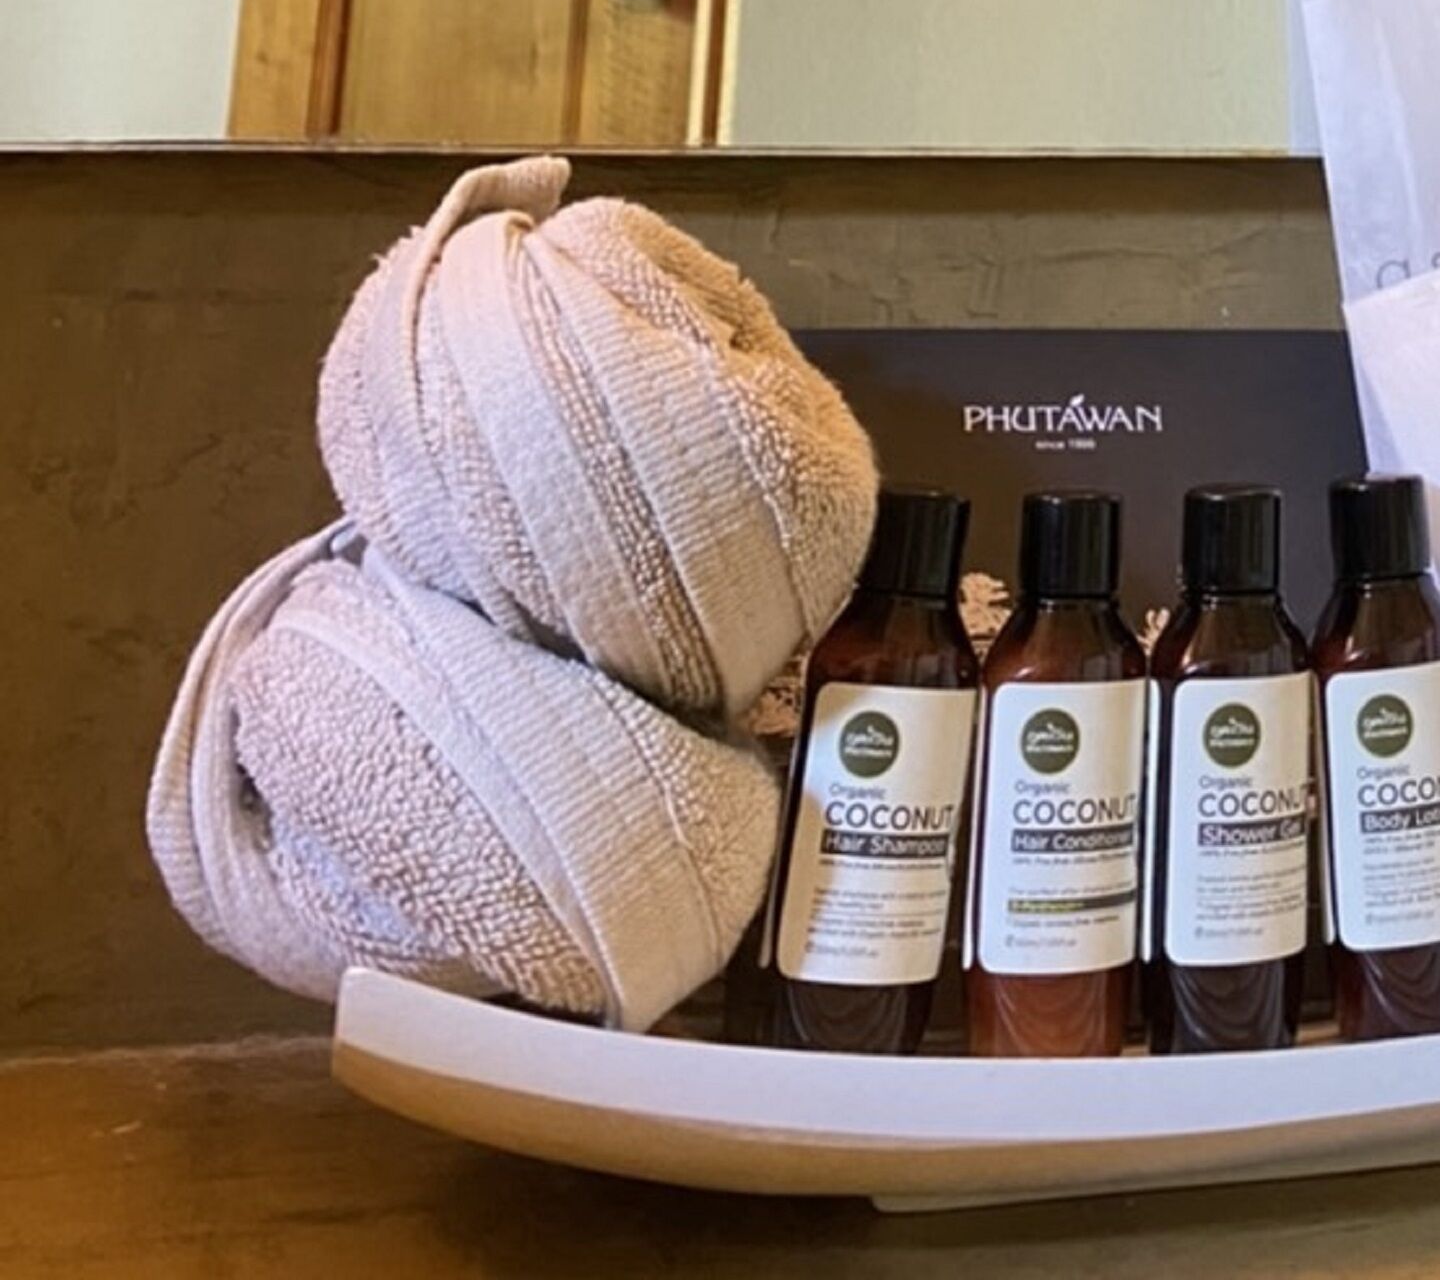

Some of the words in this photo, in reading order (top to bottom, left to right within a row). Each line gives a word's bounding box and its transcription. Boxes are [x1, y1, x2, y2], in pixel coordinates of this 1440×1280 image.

[1356, 765, 1410, 781] Organic
[828, 783, 885, 799] Organic
[1014, 779, 1070, 796] Organic
[1198, 774, 1252, 791] Organic
[825, 800, 955, 831] COCONUT
[1364, 814, 1411, 833] Body
[826, 832, 866, 852] Hair
[1014, 832, 1050, 850] Hair
